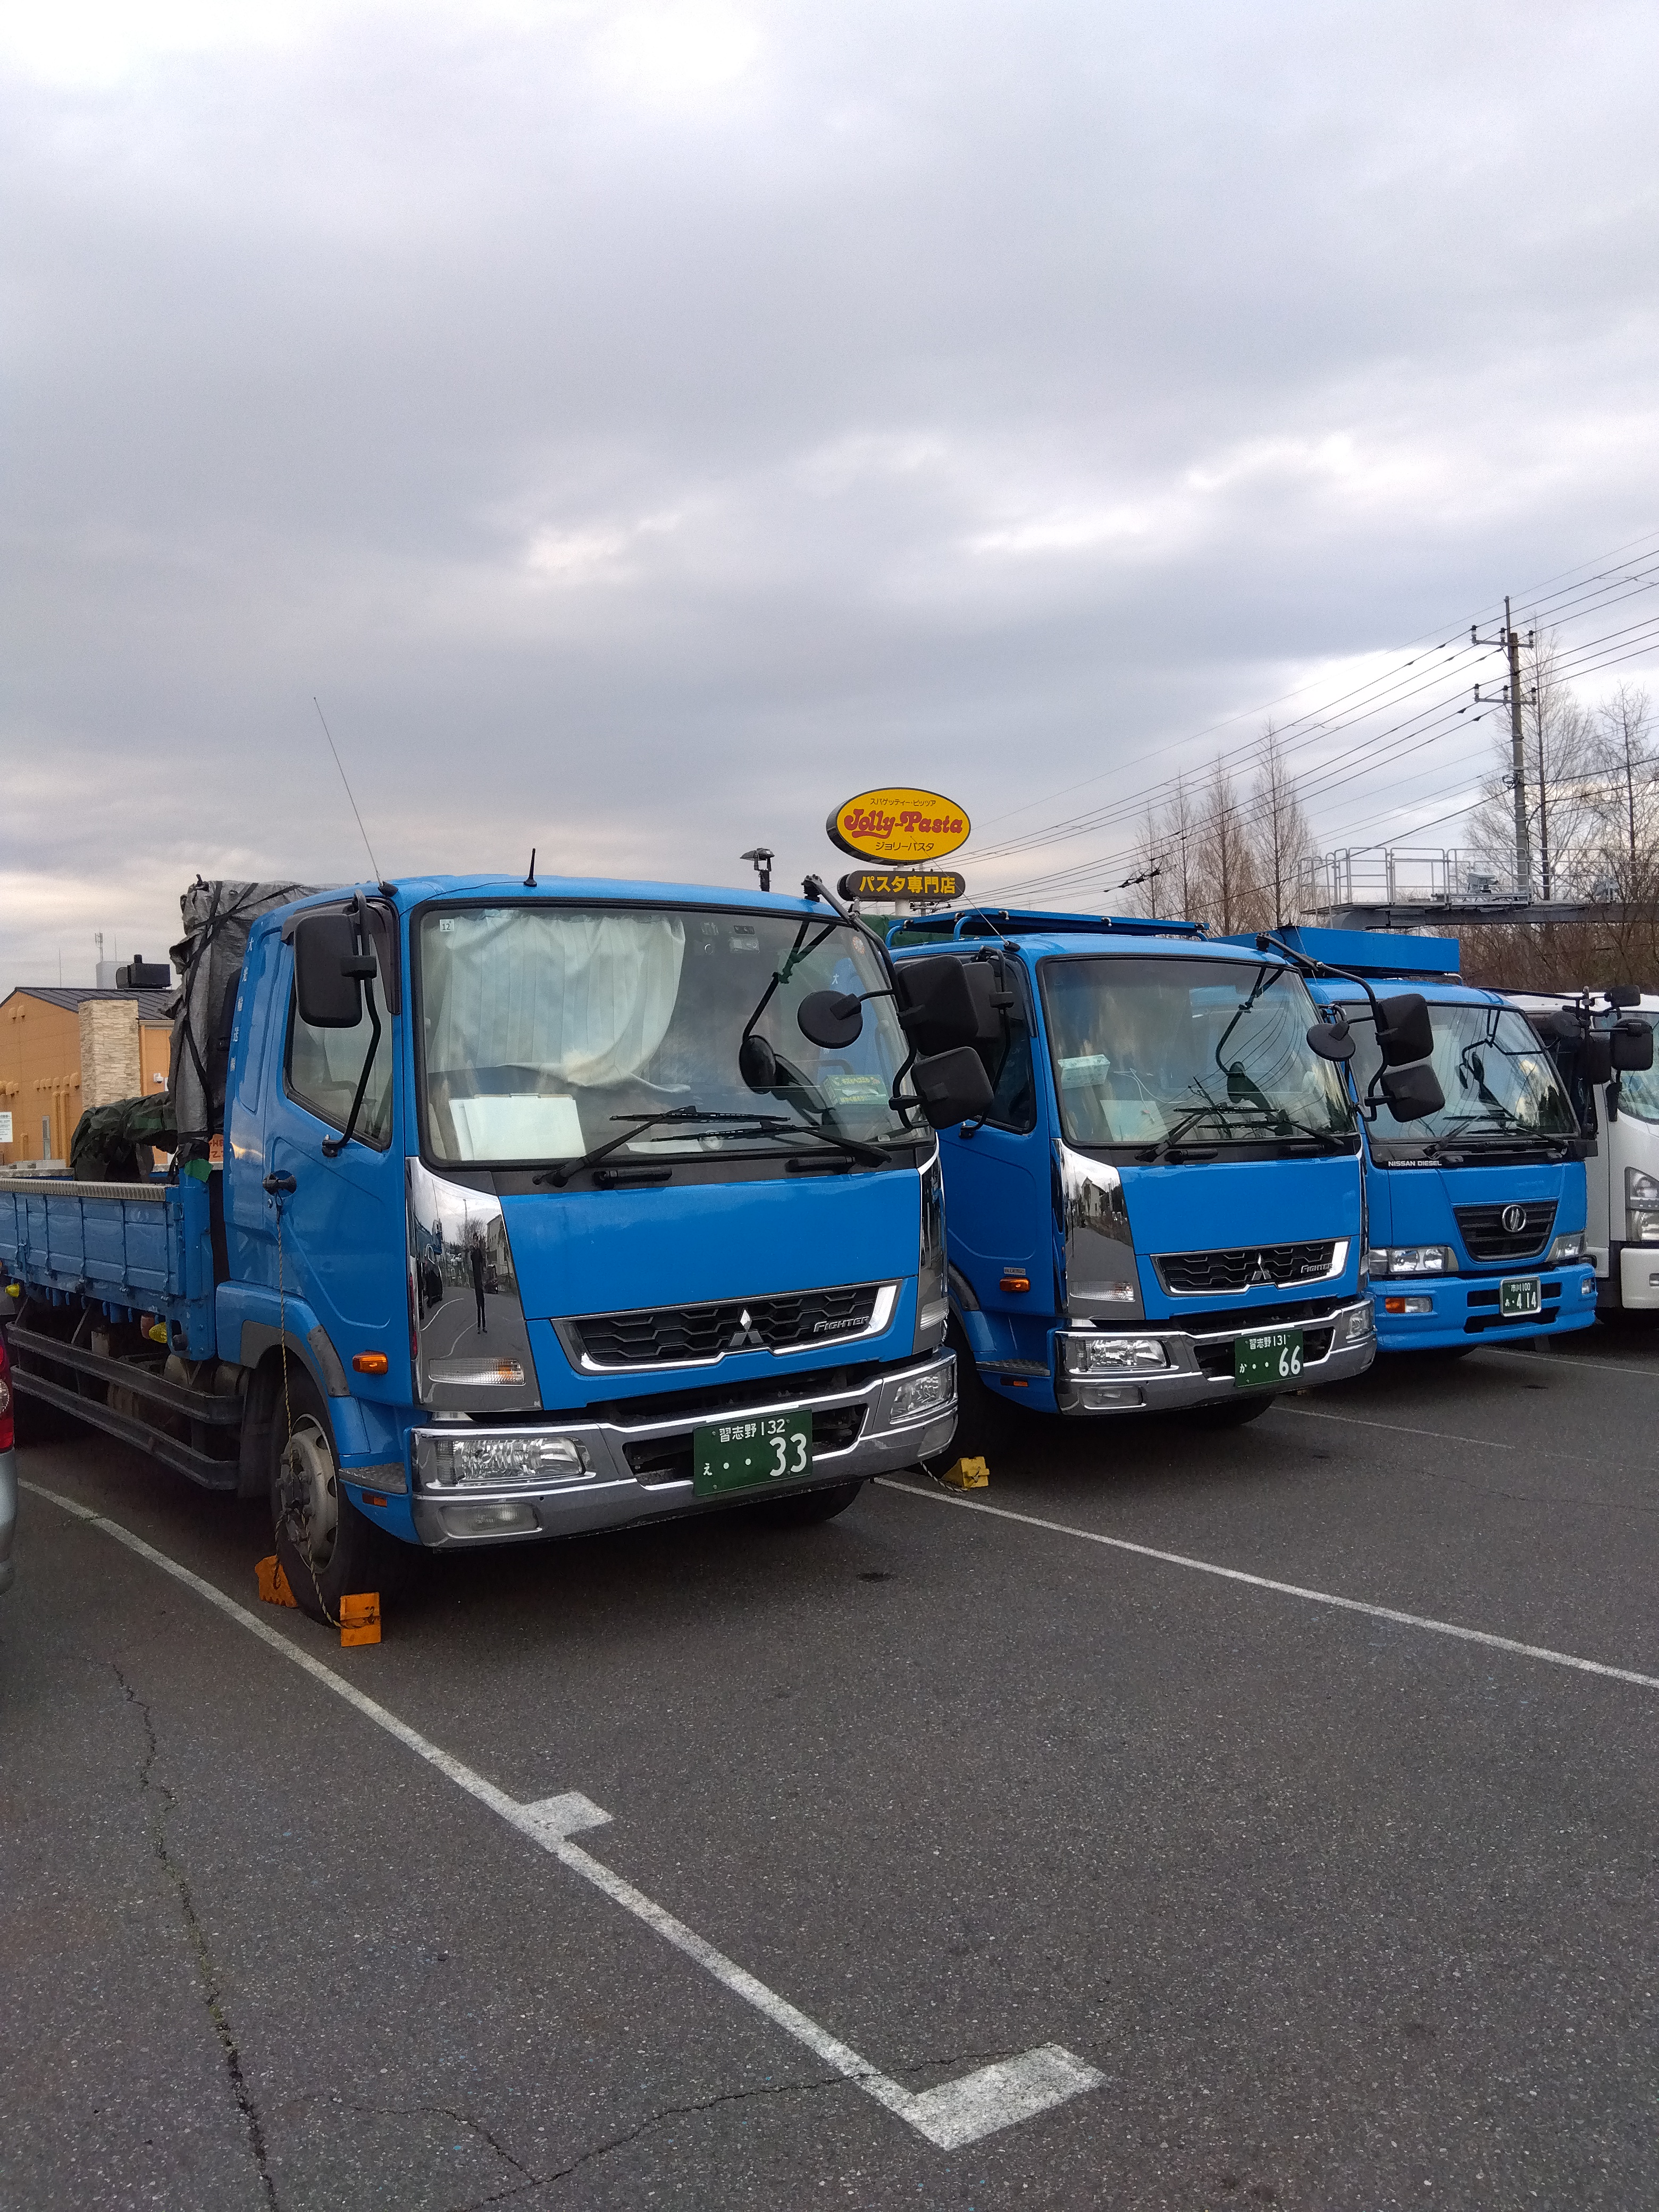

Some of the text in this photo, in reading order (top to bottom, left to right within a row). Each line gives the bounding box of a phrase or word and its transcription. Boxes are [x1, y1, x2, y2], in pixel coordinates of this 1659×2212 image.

[875, 842, 934, 852] ジョリーパスタ
[859, 875, 956, 894] パスタ専門店
[1301, 1263, 1333, 1273] FIGHTER
[813, 1316, 870, 1333] FIGHTER
